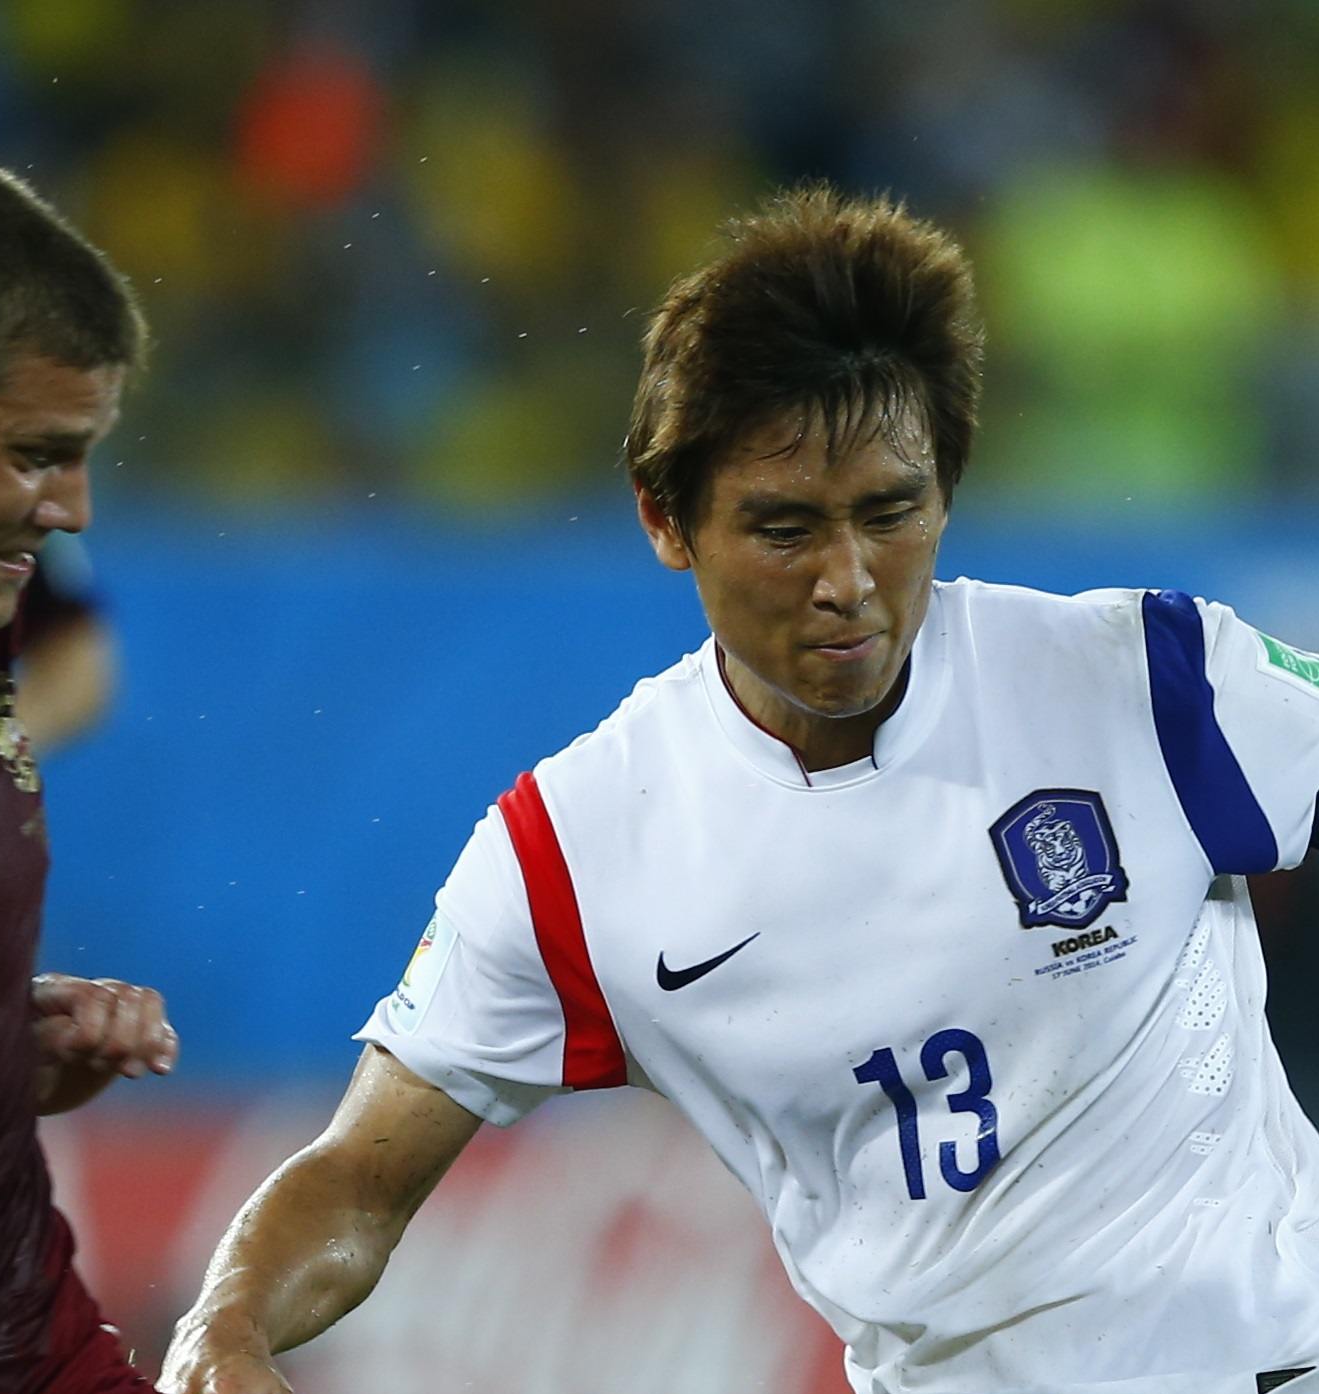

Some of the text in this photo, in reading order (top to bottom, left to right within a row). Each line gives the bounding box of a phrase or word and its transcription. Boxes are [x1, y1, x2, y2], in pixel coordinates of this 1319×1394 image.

[1034, 962, 1062, 975] RUSSIA
[1076, 950, 1102, 962] KOREA
[1104, 935, 1138, 953] REPUBLIC
[1051, 925, 1119, 957] KOREA
[851, 1027, 1002, 1201] 13
